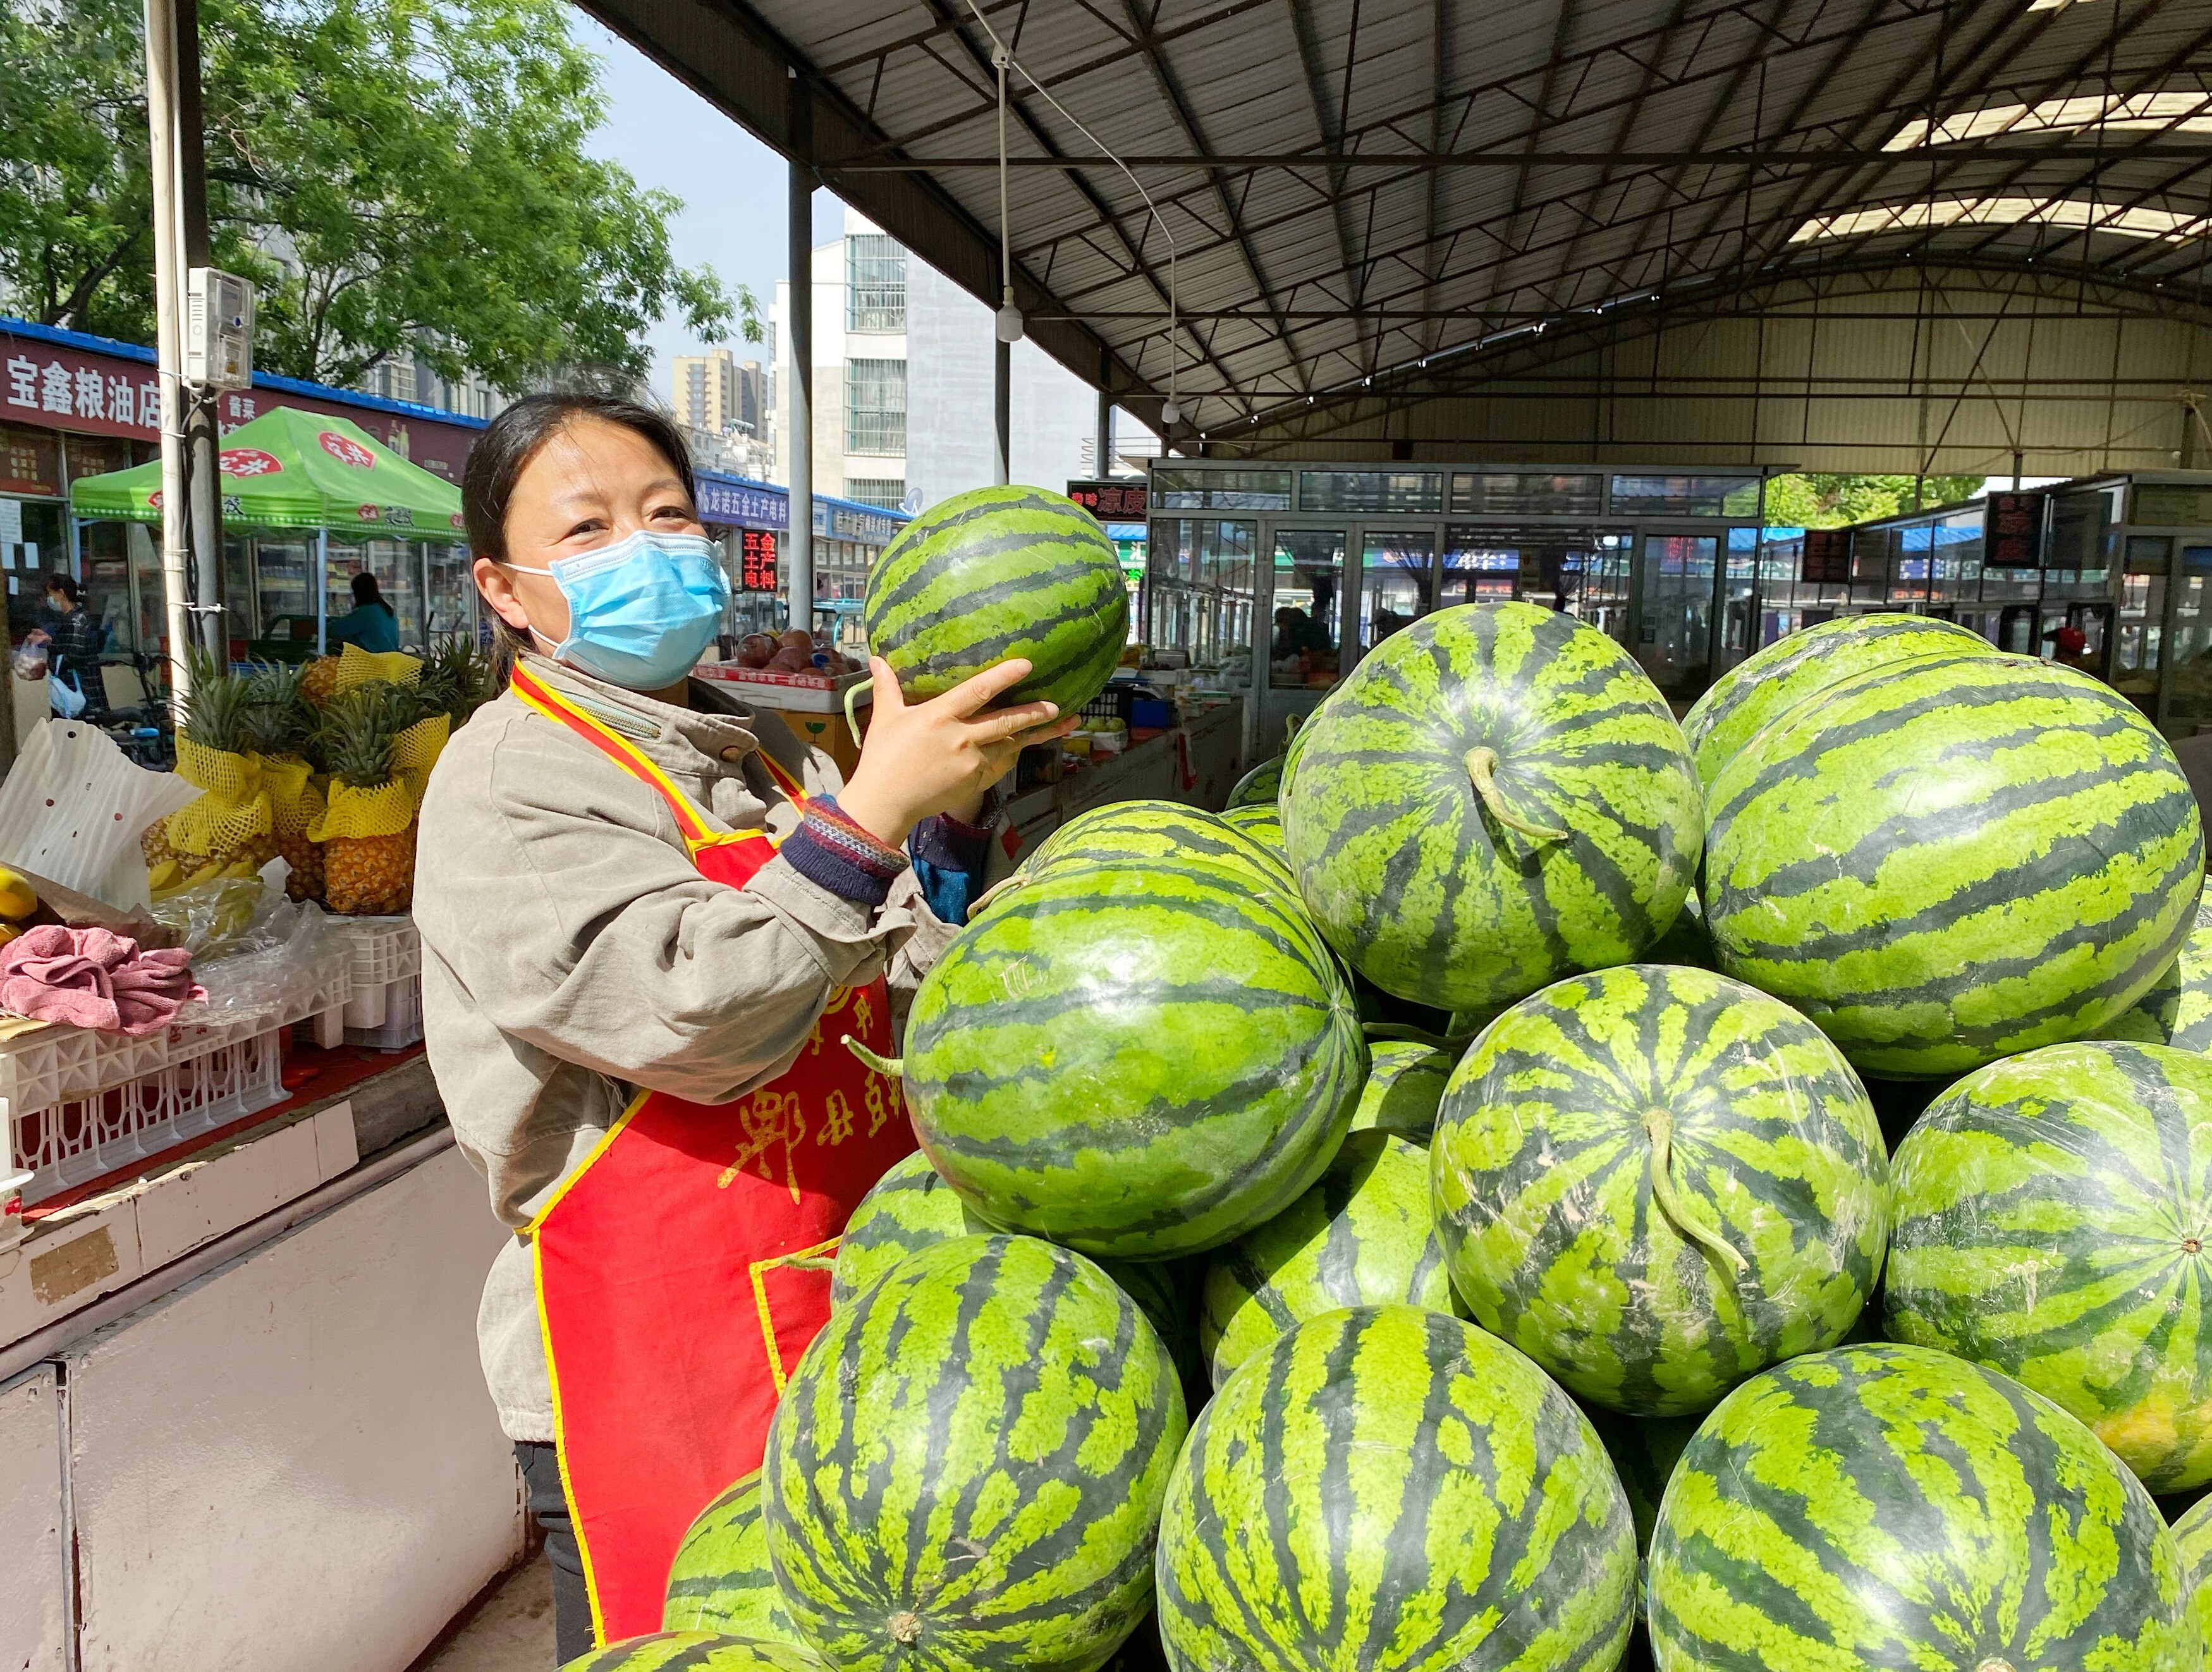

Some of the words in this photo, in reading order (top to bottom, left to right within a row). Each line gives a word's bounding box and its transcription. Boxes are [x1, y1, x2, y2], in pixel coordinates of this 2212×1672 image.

[7, 354, 161, 429] 宝鑫粮油店
[711, 487, 786, 523] 龙诺五金土产电料
[744, 533, 776, 551] 五金
[744, 551, 776, 570] 土产
[745, 570, 776, 589] 电料
